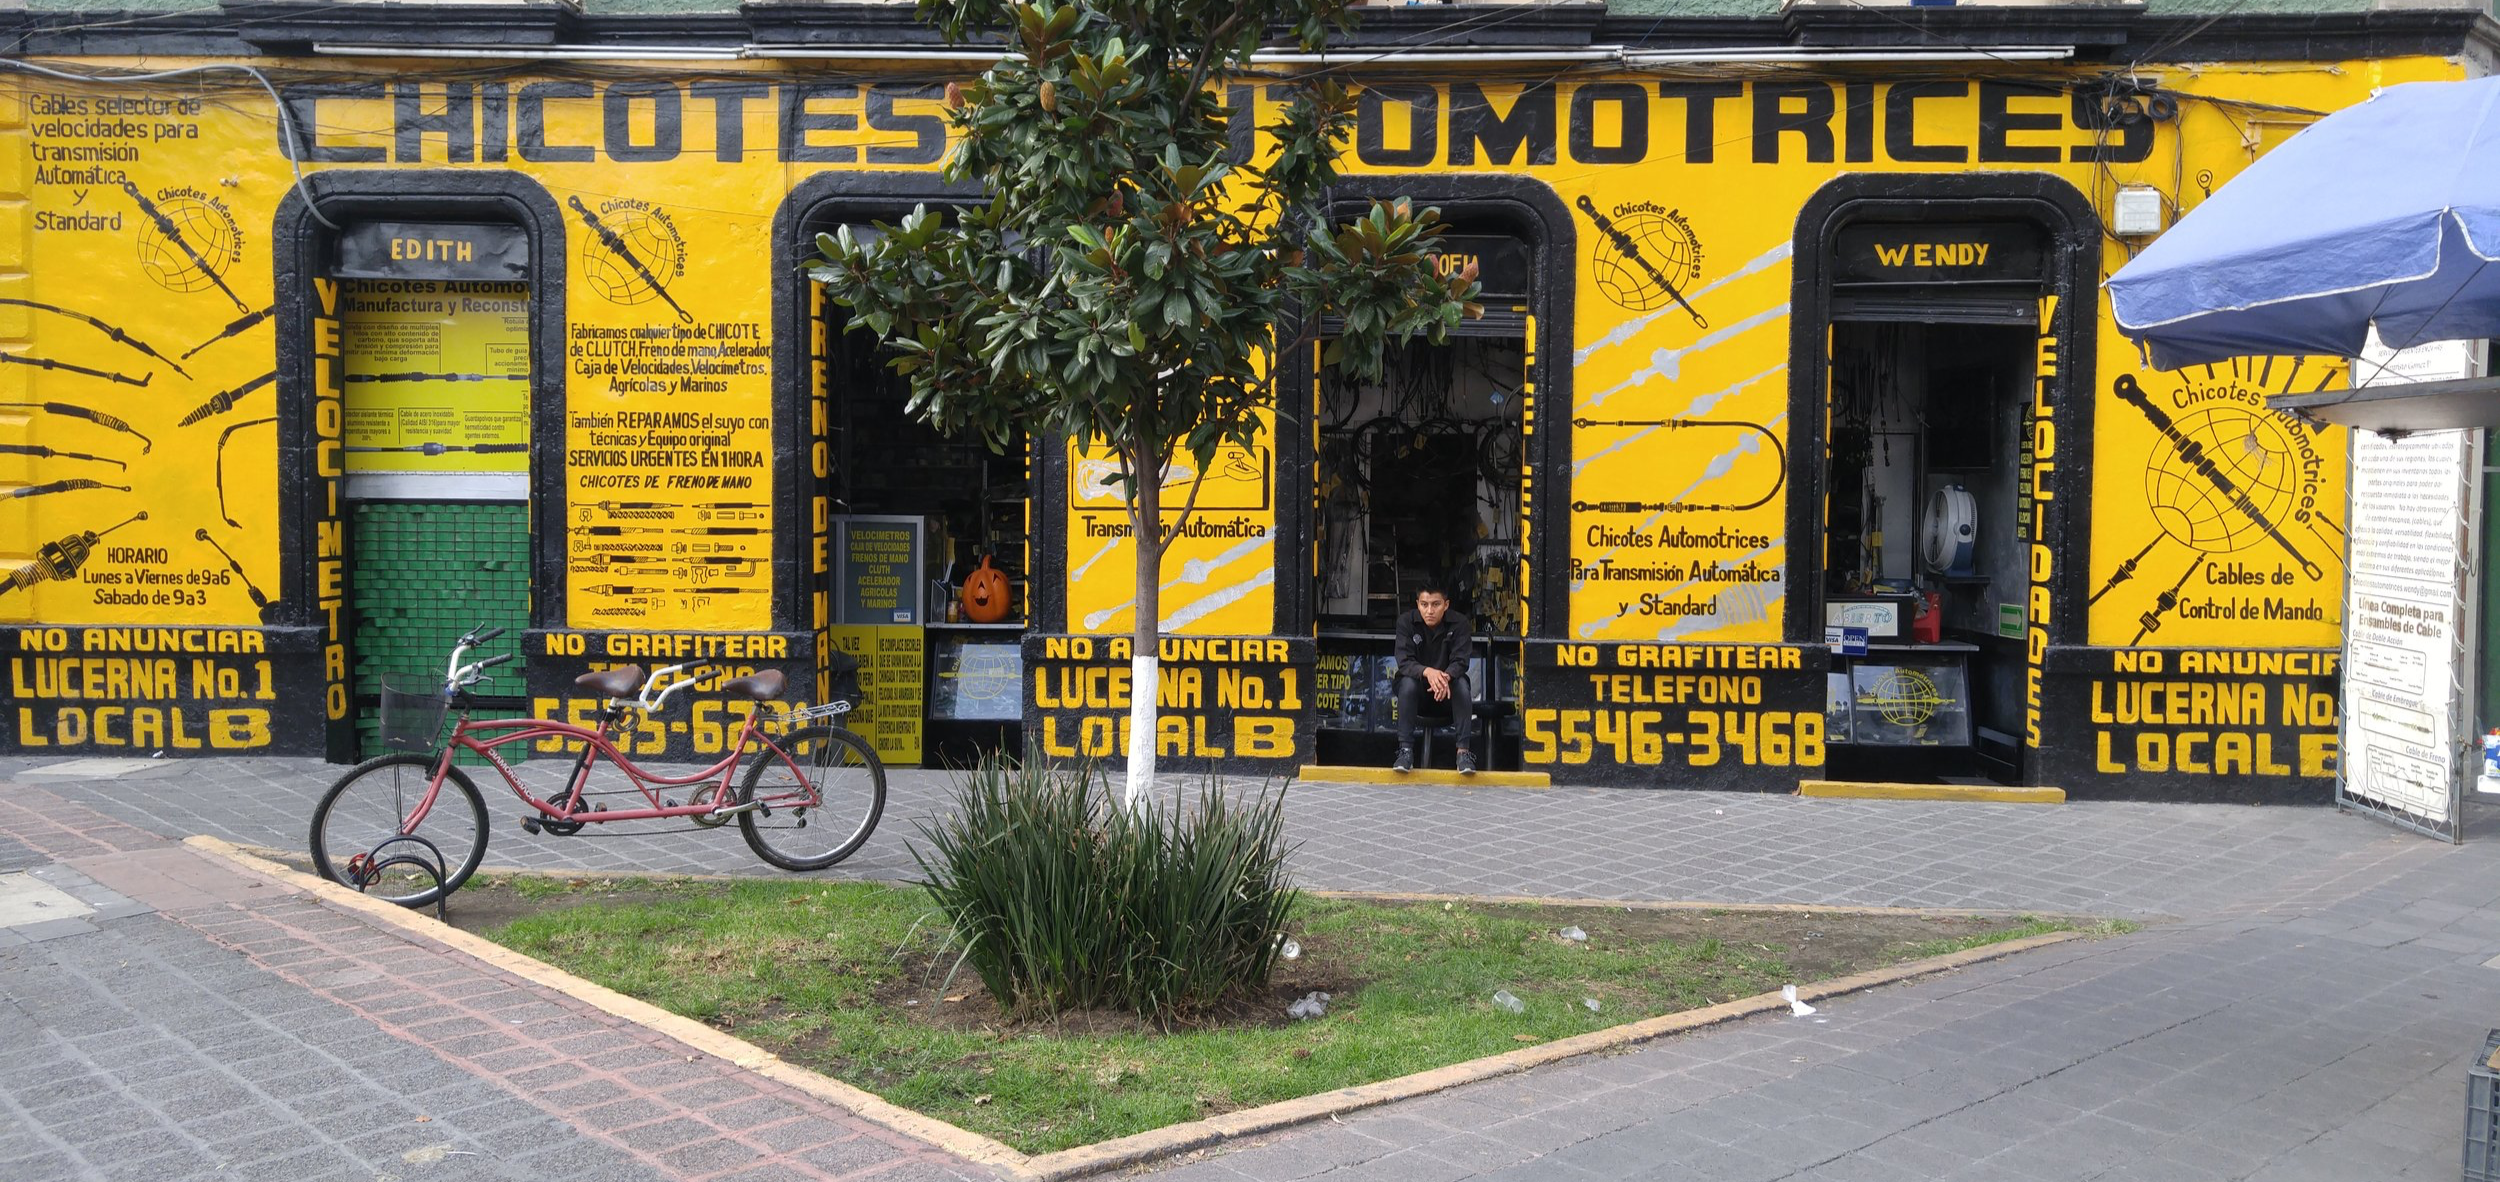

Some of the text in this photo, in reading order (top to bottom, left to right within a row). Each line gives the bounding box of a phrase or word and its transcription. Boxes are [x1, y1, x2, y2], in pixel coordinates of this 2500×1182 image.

[30, 93, 200, 116] Cables selector de
[31, 119, 199, 143] velocidades para
[277, 80, 2157, 166] CHICOTES OMOTRICES
[30, 141, 139, 162] transmisión
[34, 165, 126, 186] Automática
[73, 189, 88, 206] y
[34, 211, 122, 231] Standard
[157, 186, 246, 263] Chicotes Automotrices
[600, 197, 688, 278] Chicotes Automotrices
[1612, 200, 1706, 280] Chicotes Automotrices
[390, 238, 473, 262] EDITH
[1873, 243, 1990, 267] WENDY
[1440, 254, 1478, 277] OFIA
[343, 280, 530, 294] Chicotes Automo
[344, 297, 529, 317] Manufactura y Reconst
[571, 323, 628, 340] Fabricamos
[630, 323, 672, 343] cualquier
[671, 323, 693, 343] tipo
[693, 323, 707, 339] de
[569, 342, 583, 358] de
[671, 341, 685, 358] de
[574, 358, 601, 379] Caja
[604, 359, 618, 375] de
[608, 376, 728, 397] Agrícolas y Marinos
[568, 411, 769, 434] También REPARAMOS el suyo con
[589, 429, 732, 452] técnicas y Equipo original
[568, 449, 628, 467] SERVICIOS
[630, 450, 698, 468] URGENTES
[2172, 381, 2261, 410] Chicotes
[2264, 404, 2328, 526] utomotrices
[579, 475, 753, 490] CHICOTES DE FRENO DE MANO
[313, 277, 346, 721] VELOCIMETRO
[809, 279, 830, 749] FRENO DE MAN
[2026, 295, 2060, 749] VELOCIDADES
[851, 531, 910, 541] VELOCIMETROS
[1174, 515, 1266, 539] Automática
[1587, 525, 1770, 549] Chicotes Automotrices
[107, 547, 169, 564] HORARIO
[850, 542, 911, 552] CAJA DE VELOCIDADES
[851, 553, 909, 563] FRENOS DE MANO
[83, 569, 123, 585] Lunes
[125, 572, 136, 585] a
[135, 568, 184, 585] Viernes
[858, 576, 901, 586] ACELERADOR
[868, 565, 891, 575] CLUTH
[1570, 557, 1780, 583] Para Transmisión Automática
[2206, 561, 2295, 586] Cables de
[92, 588, 149, 607] Sabado
[152, 589, 171, 606] de
[860, 588, 898, 597] AGRICOLAS
[860, 600, 897, 609] Y MARINOS
[1616, 593, 1717, 618] y Standard
[2180, 596, 2324, 621] Control de Mando
[2358, 596, 2445, 623] Línea Completa para
[2359, 613, 2442, 640] Ensambles de Cable
[20, 628, 266, 654] NO ANUNCIAR
[546, 633, 788, 659] NO GRAFITEAR
[851, 636, 860, 650] VEZ
[1045, 637, 1094, 660] NO
[1109, 637, 1290, 663] AUNCIAR
[1557, 644, 1802, 670] NO GRAFITEAR
[2113, 650, 2164, 673] NO
[12, 657, 178, 700] LUCERNA
[1035, 666, 1203, 709] LUCENA
[1331, 674, 1352, 691] TIPO
[1590, 674, 1762, 705] TELEFONO
[2091, 680, 2340, 727] LUCERNA No.
[19, 706, 202, 749] LOCAL
[1233, 716, 1296, 759] B
[1523, 708, 1826, 767] 5546-3468
[2096, 730, 2292, 777] LOCAL
[2430, 753, 2447, 764] Freno
